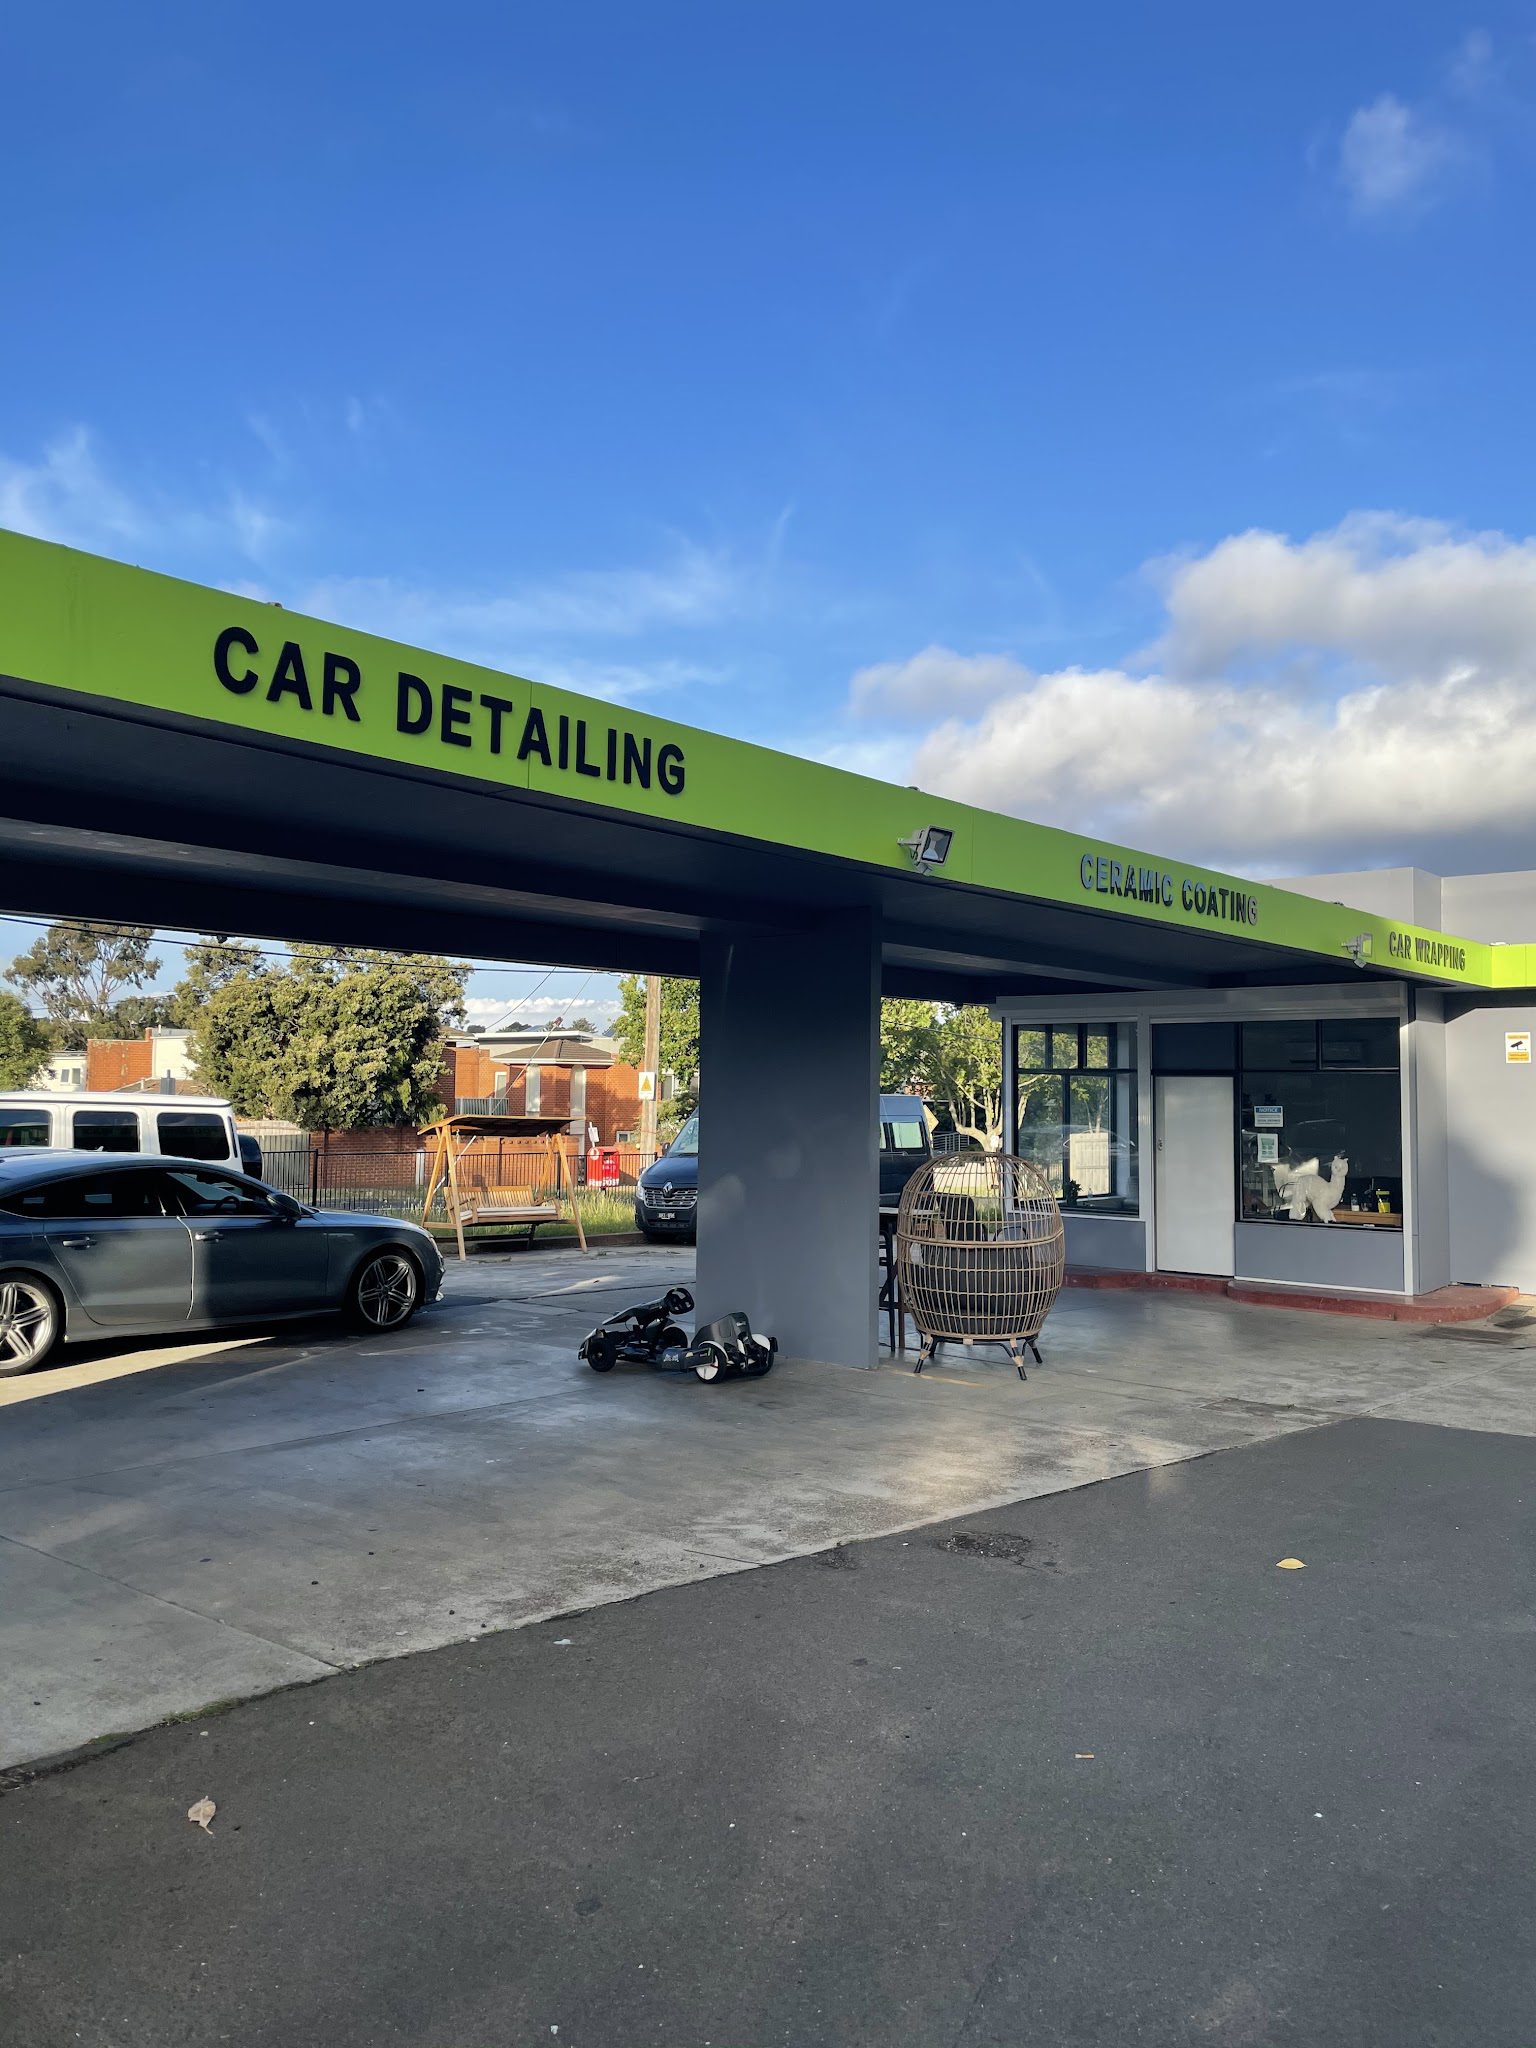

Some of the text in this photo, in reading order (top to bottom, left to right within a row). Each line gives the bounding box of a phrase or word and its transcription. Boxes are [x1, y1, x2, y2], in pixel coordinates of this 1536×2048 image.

[214, 626, 686, 796] CAR DETAILING
[1080, 853, 1258, 926] CERAMIC COATING
[1389, 931, 1466, 971] CAR WRAPPING
